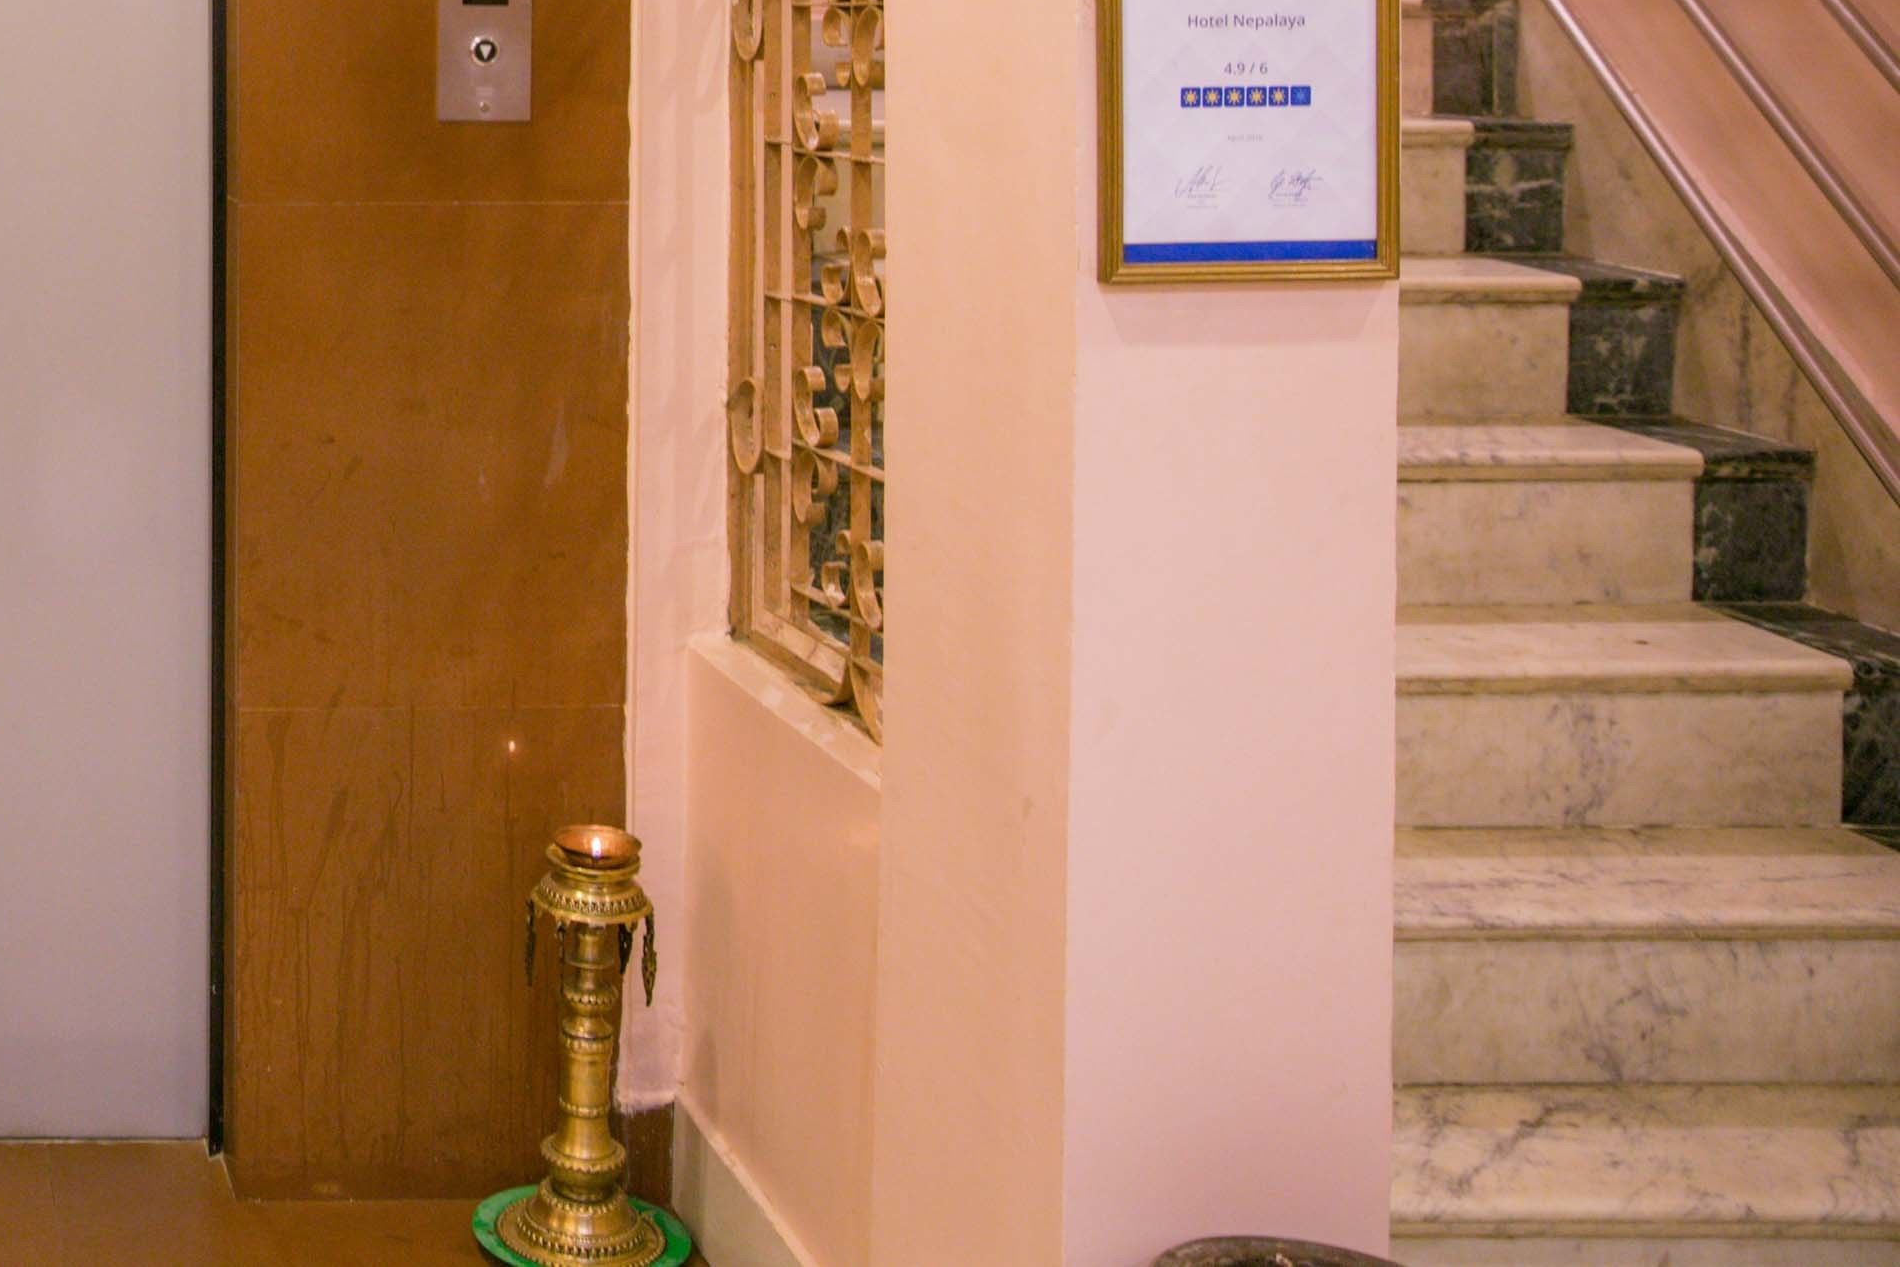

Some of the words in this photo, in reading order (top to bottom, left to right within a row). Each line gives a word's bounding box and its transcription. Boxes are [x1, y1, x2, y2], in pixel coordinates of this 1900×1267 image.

[1187, 12, 1229, 28] Hotel
[1233, 12, 1306, 31] Nepalaya
[1223, 61, 1246, 75] 4.9
[1259, 61, 1269, 75] 6
